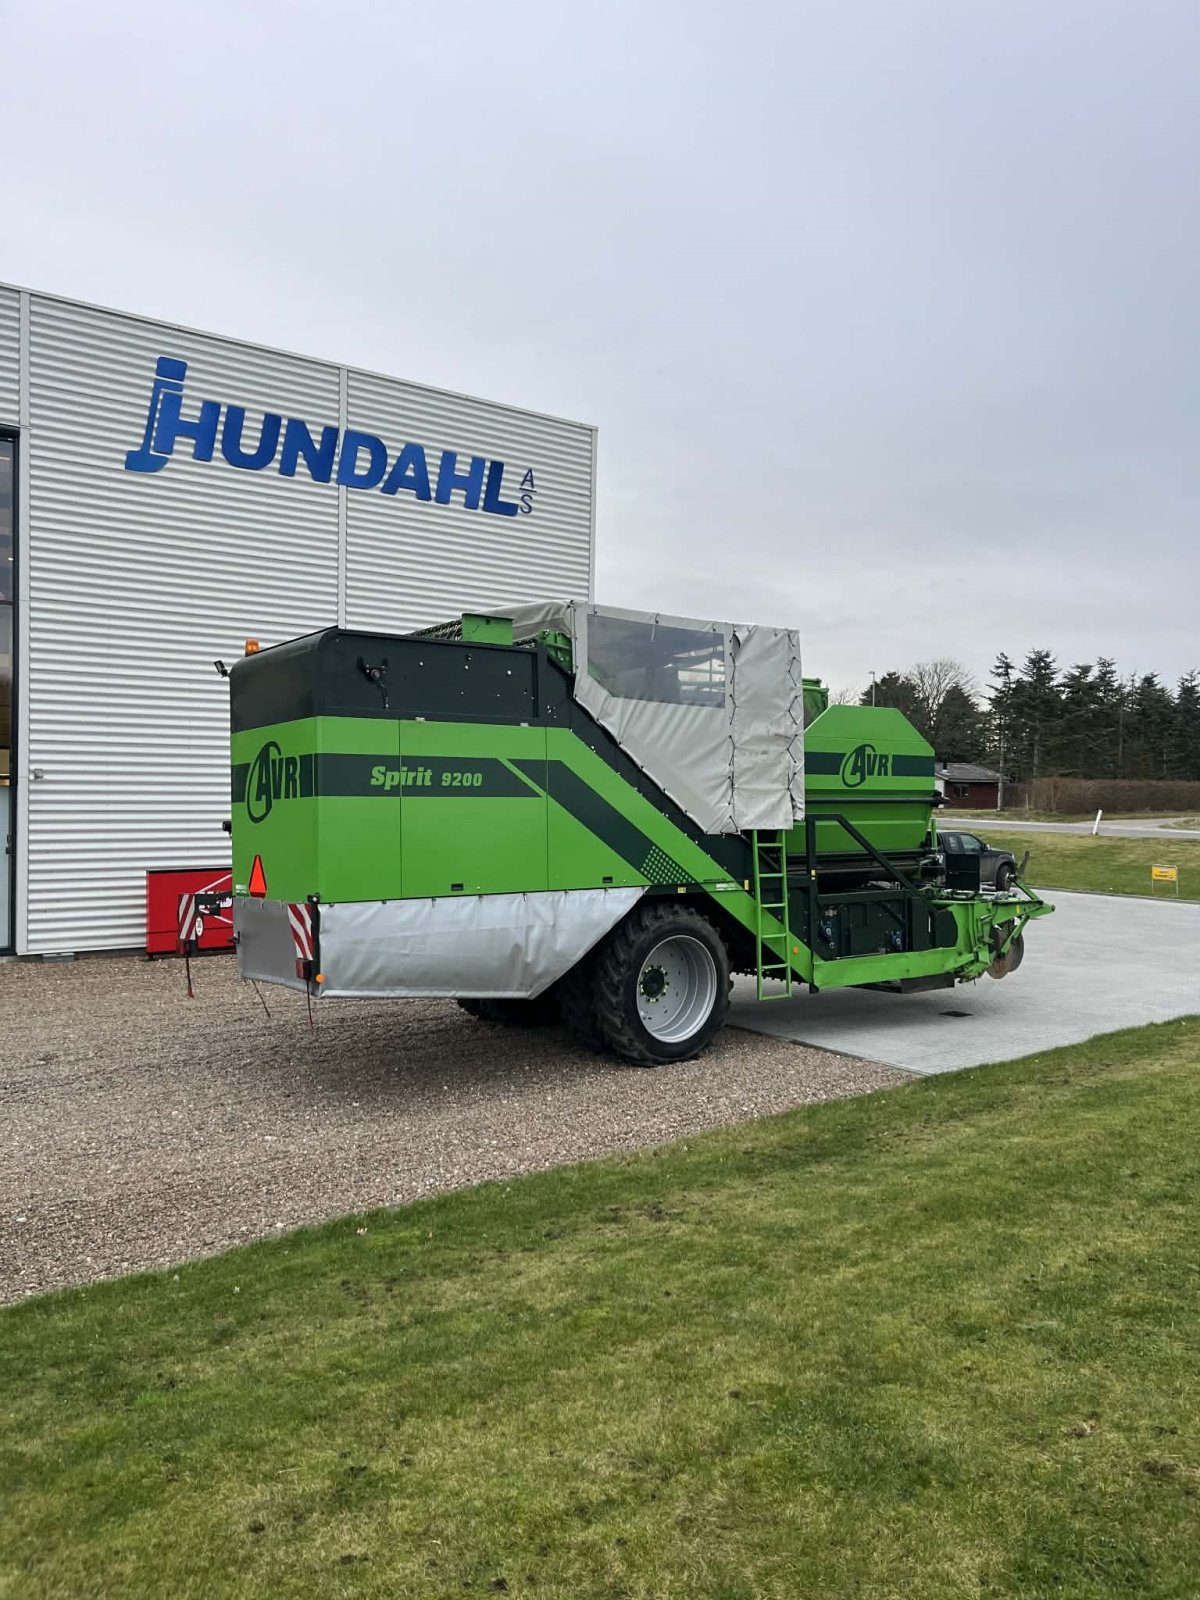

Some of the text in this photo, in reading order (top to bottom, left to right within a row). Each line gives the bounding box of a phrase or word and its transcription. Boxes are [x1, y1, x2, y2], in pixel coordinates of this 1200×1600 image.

[247, 741, 298, 824] AVR
[370, 766, 482, 790] Spirit 9200
[842, 744, 889, 788] AVR
